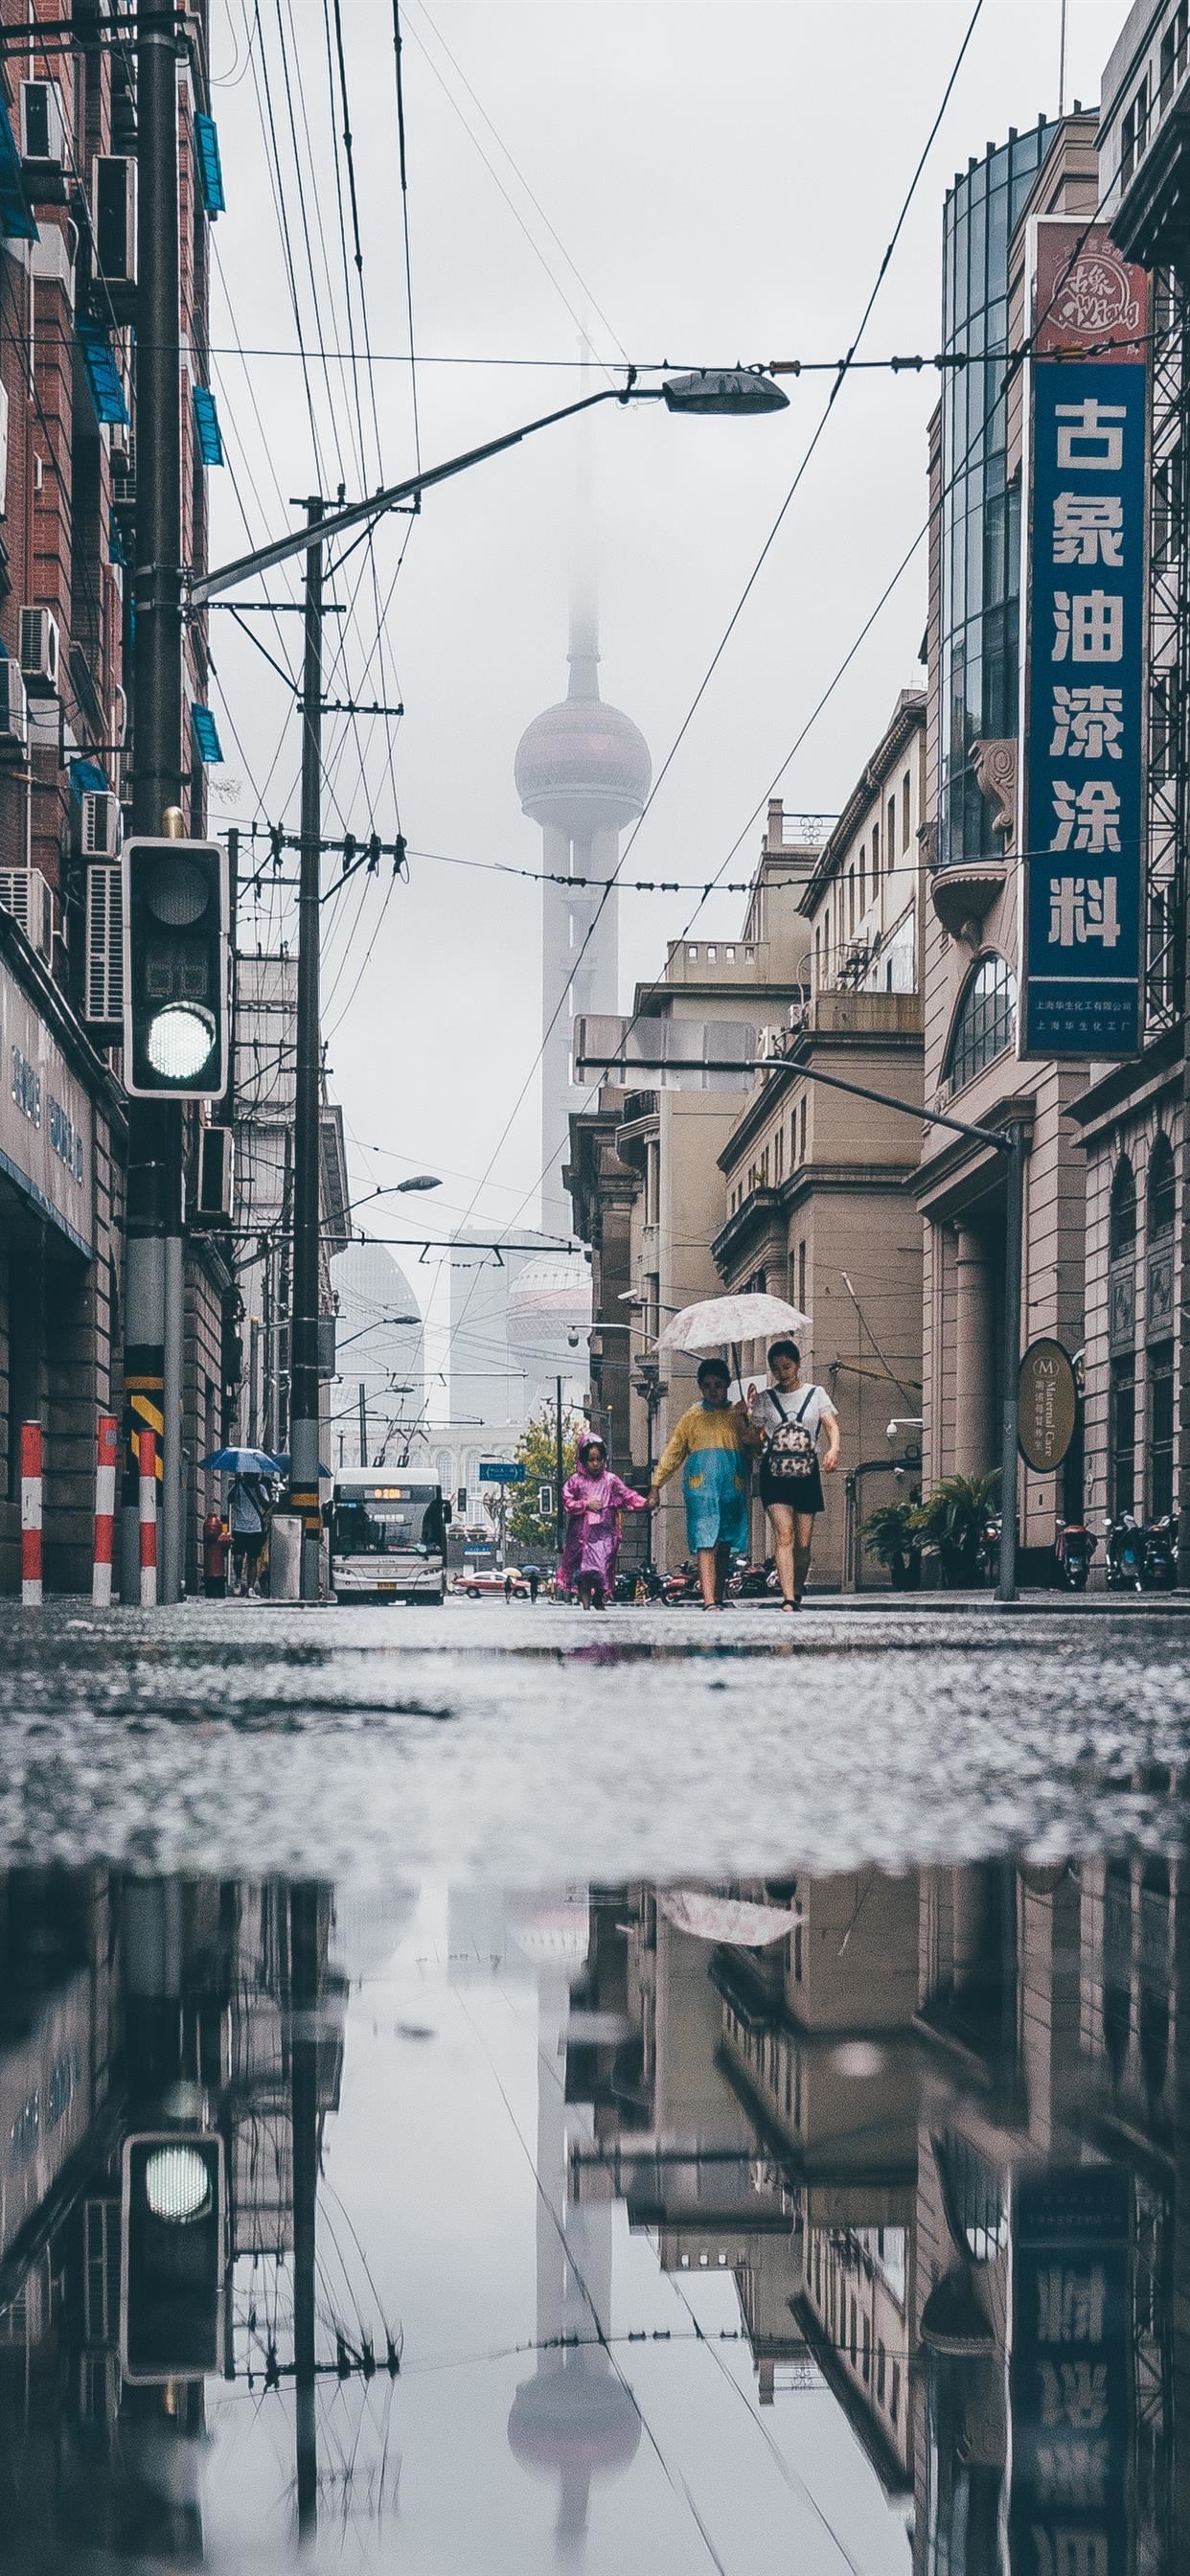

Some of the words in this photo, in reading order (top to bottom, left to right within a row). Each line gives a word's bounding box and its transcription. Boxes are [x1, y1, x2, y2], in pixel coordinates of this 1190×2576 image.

[1048, 399, 1127, 947] 古象油漆涂料
[1035, 1000, 1132, 1012] 上海华生化工有限公司
[1036, 1021, 1131, 1032] 上海华生化工厂
[1045, 1380, 1057, 1428] Maternal
[1044, 1431, 1055, 1457] Care
